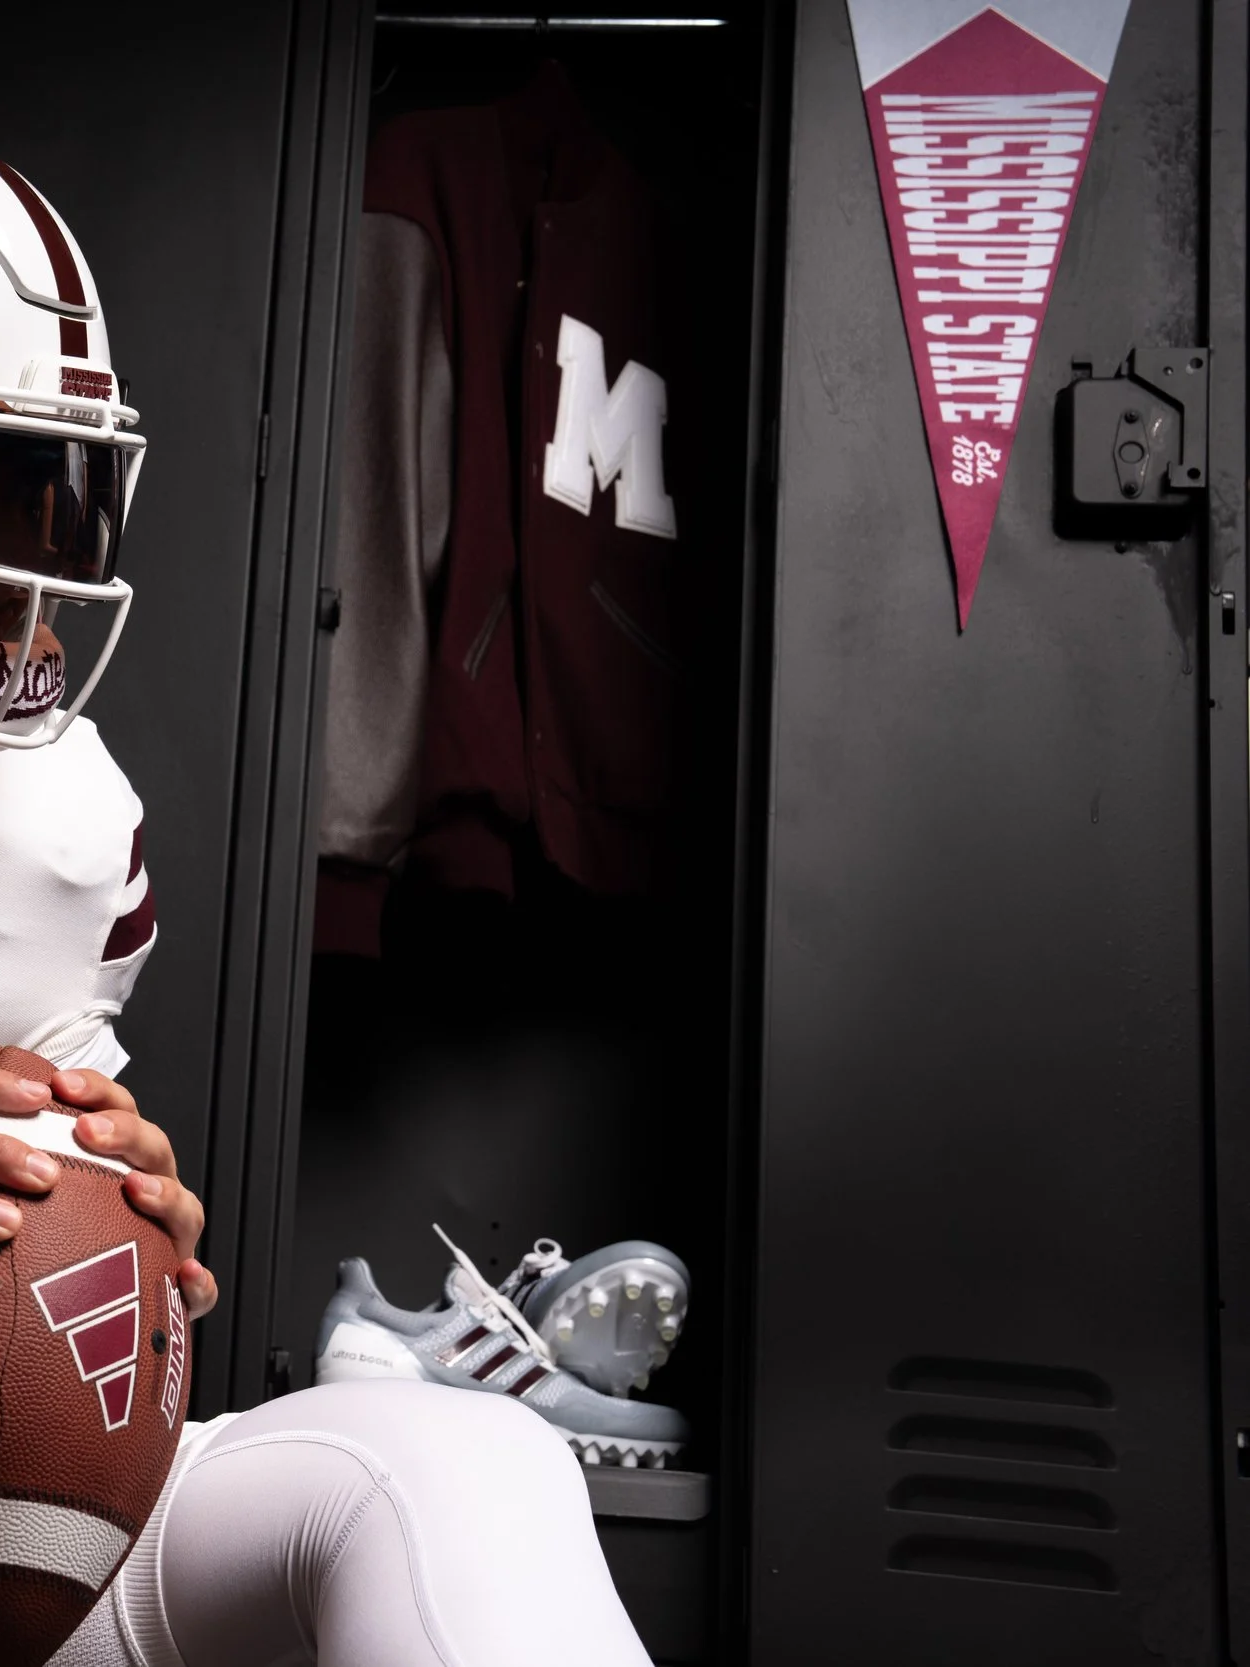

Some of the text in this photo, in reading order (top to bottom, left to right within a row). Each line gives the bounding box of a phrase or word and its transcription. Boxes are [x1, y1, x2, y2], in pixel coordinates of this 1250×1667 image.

[880, 91, 1097, 424] MISSISSIPPI STATE
[542, 313, 678, 540] M
[951, 434, 975, 487] 1878
[973, 440, 1002, 485] Est.
[161, 1274, 184, 1431] DIME
